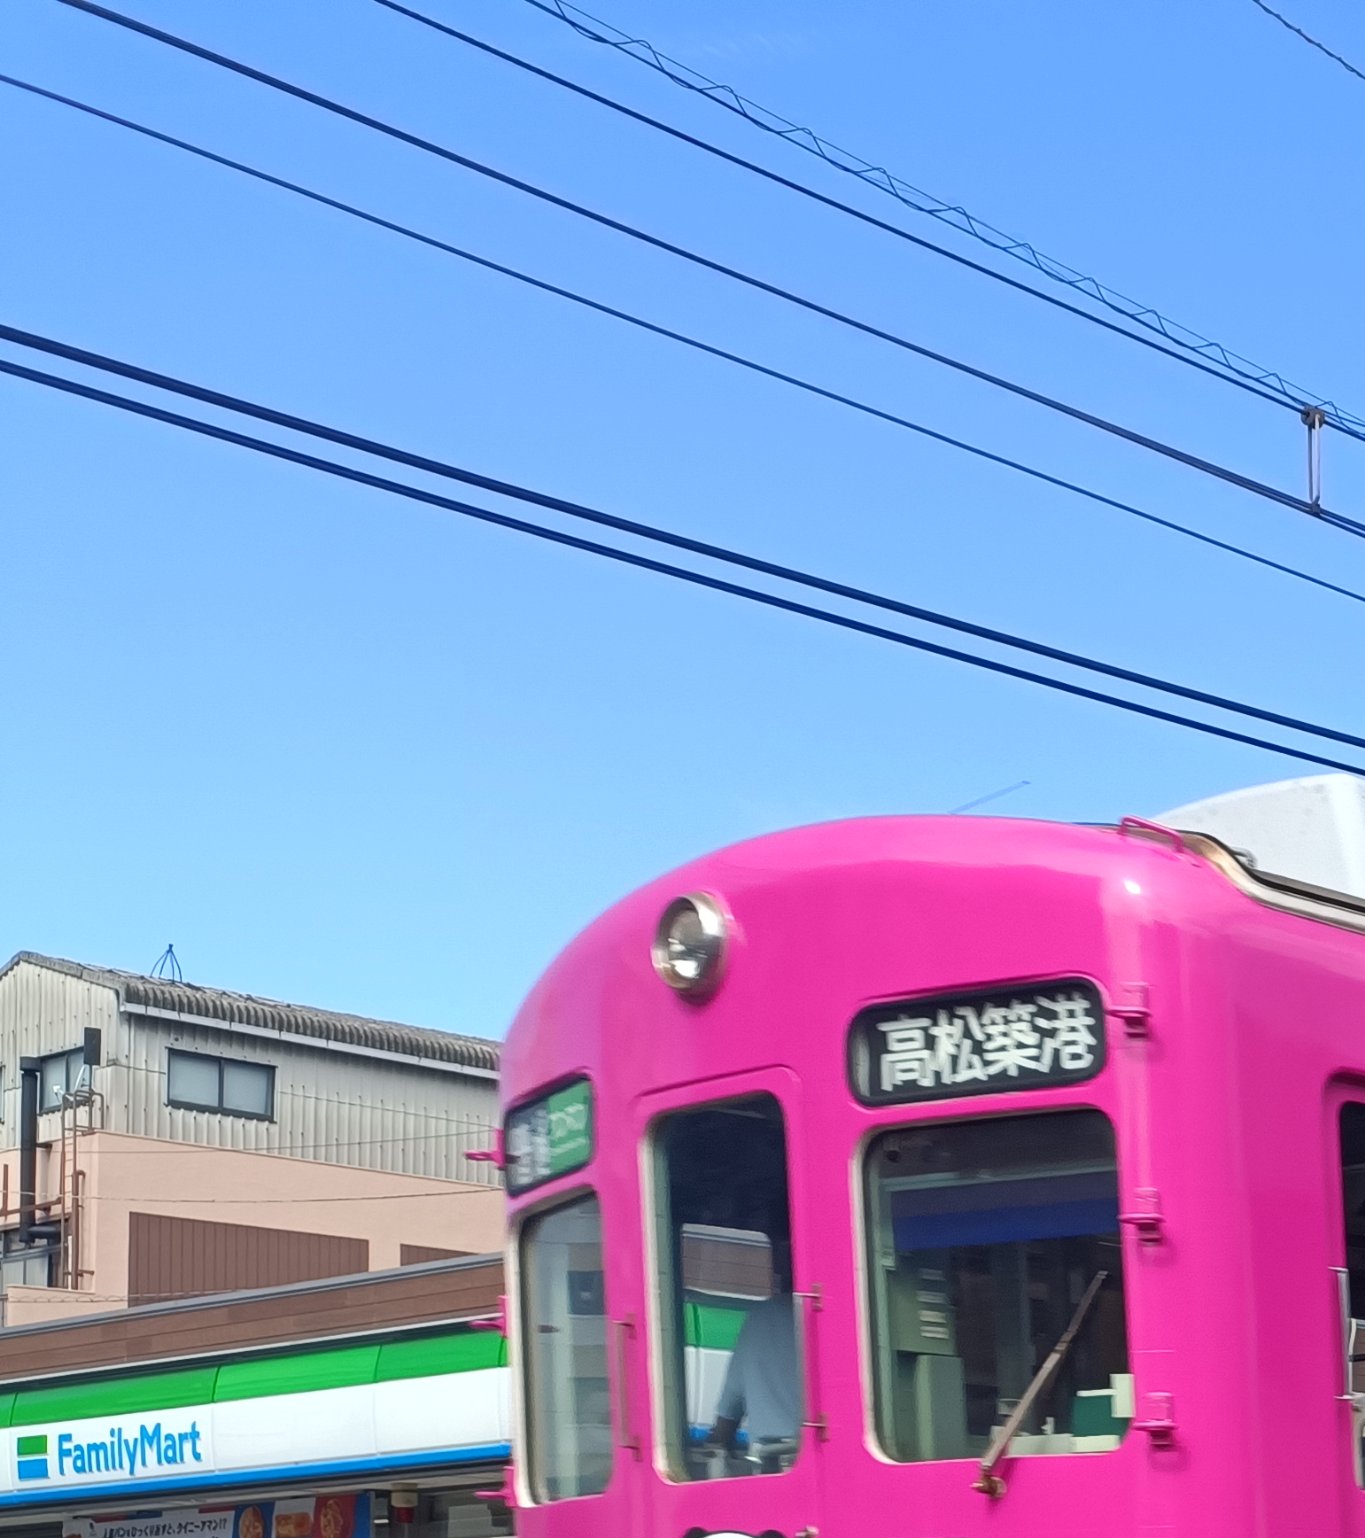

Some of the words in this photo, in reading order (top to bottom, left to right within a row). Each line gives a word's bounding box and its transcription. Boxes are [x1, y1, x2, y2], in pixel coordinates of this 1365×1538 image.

[875, 993, 1097, 1091] 高松築港
[58, 1421, 202, 1476] FamilyMart
